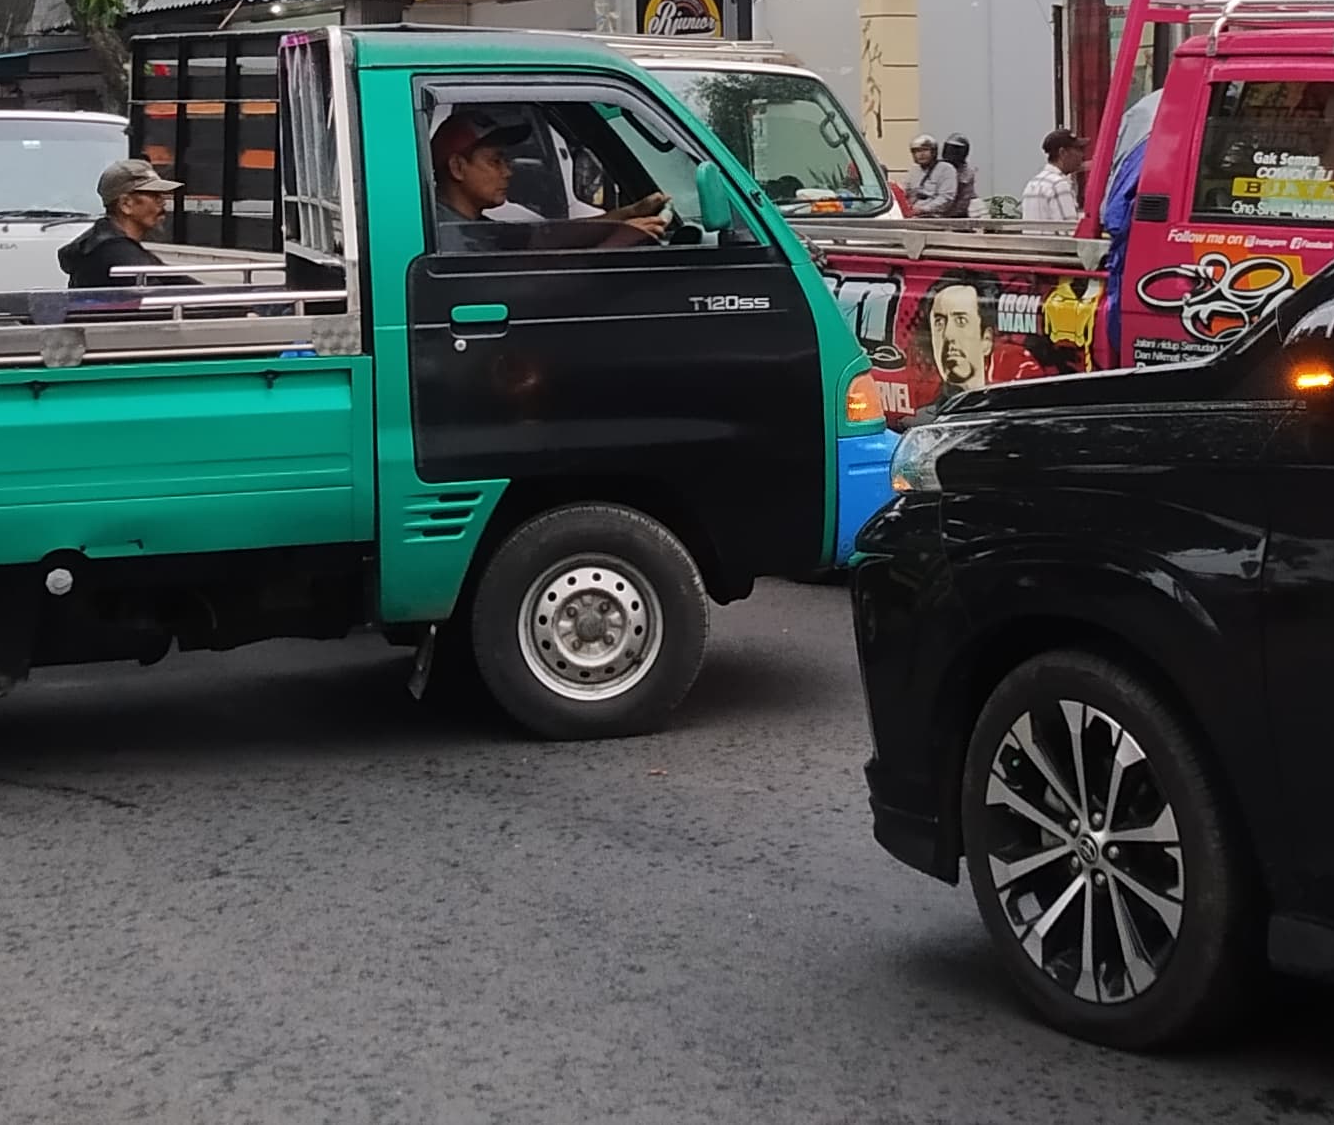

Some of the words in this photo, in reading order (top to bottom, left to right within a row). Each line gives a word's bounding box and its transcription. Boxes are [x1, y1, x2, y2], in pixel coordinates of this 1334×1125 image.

[1253, 151, 1278, 166] Gak
[1167, 229, 1205, 243] Follow
[1206, 233, 1226, 244] me
[1227, 235, 1243, 246] on
[998, 293, 1042, 313] IRON
[998, 313, 1038, 334] MAN
